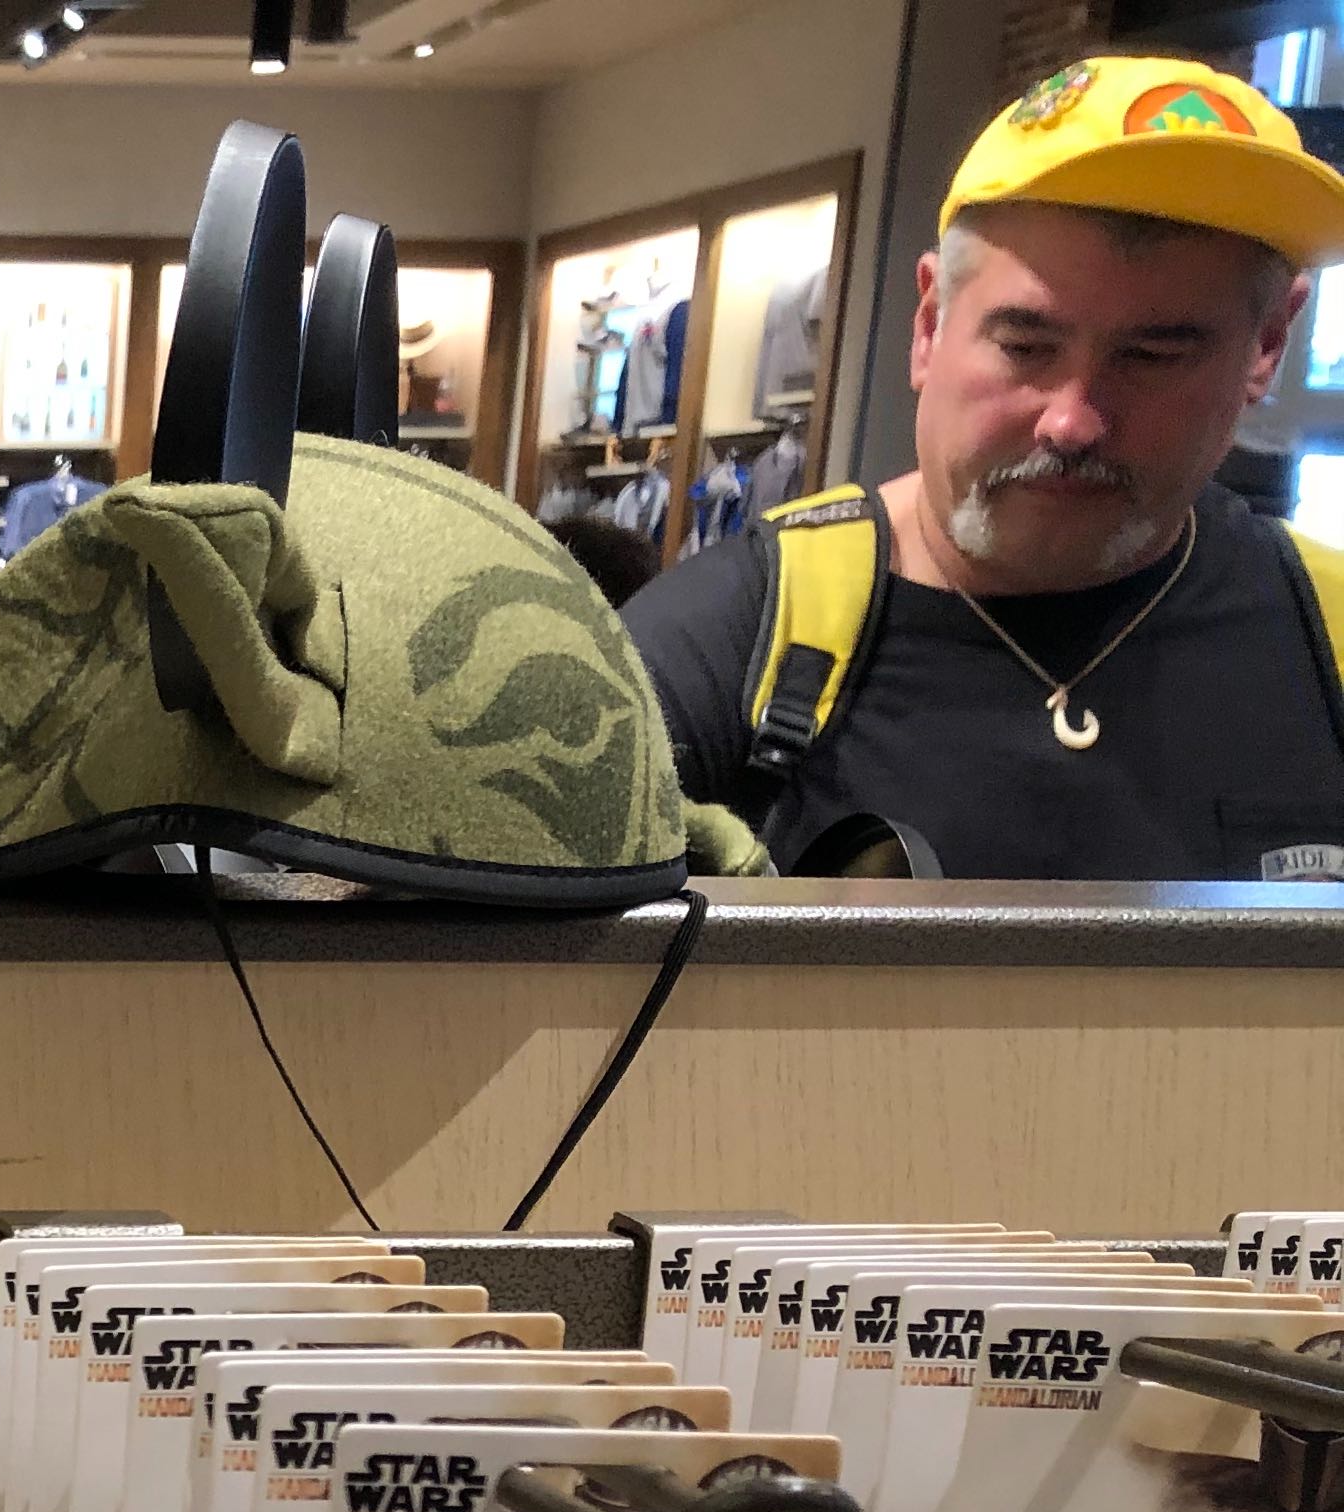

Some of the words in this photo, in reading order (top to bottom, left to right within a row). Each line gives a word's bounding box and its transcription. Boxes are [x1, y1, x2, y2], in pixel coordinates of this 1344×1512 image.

[907, 1309, 985, 1334] STA
[990, 1328, 1110, 1355] STAR
[989, 1354, 1109, 1381] WARS
[976, 1386, 1103, 1411] MANDALORIAN
[345, 1455, 485, 1485] STAR
